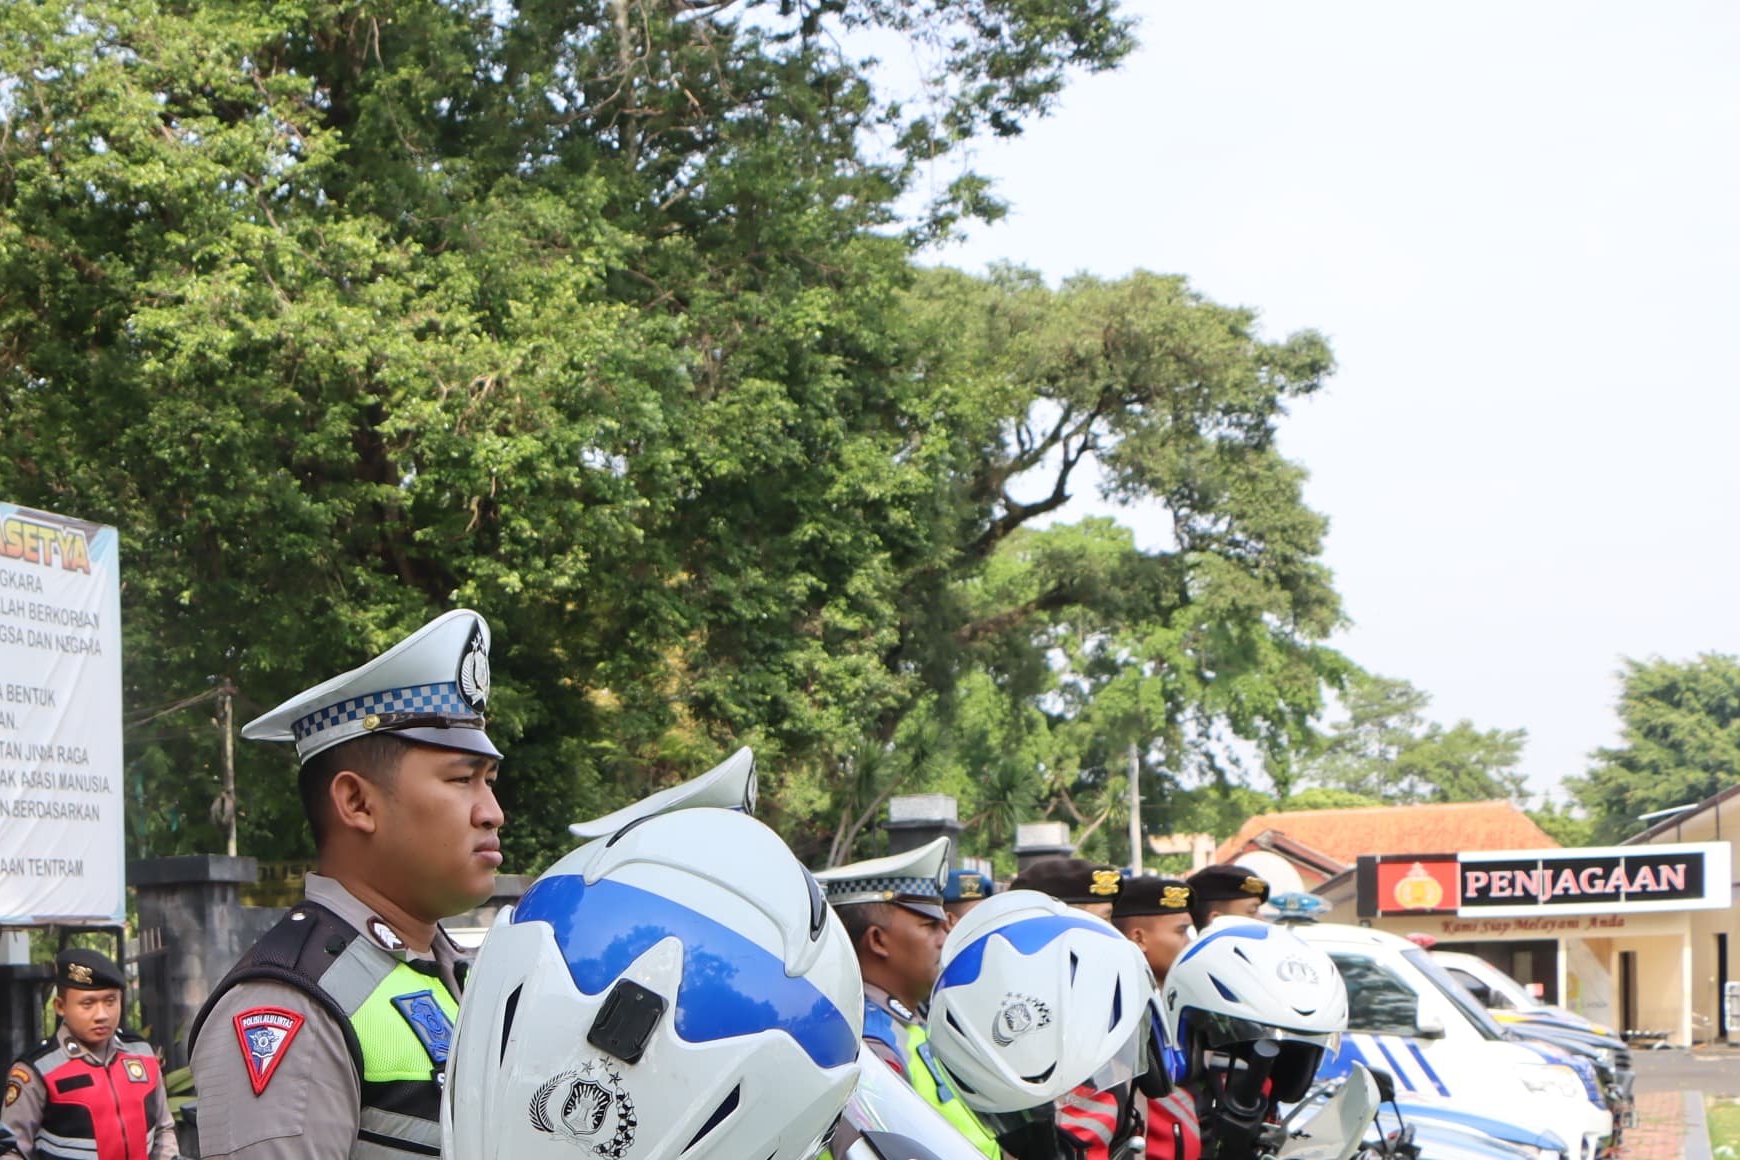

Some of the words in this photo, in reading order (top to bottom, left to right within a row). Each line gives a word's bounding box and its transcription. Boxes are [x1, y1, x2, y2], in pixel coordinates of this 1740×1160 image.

[27, 629, 52, 650] DAN
[6, 683, 56, 708] BENTUK
[57, 745, 89, 765] RAGA
[58, 772, 114, 795] MANUSIA.
[12, 799, 100, 822] BERDASARKAN
[28, 858, 84, 879] TENTRAM
[1465, 864, 1687, 902] PENJAGAAN
